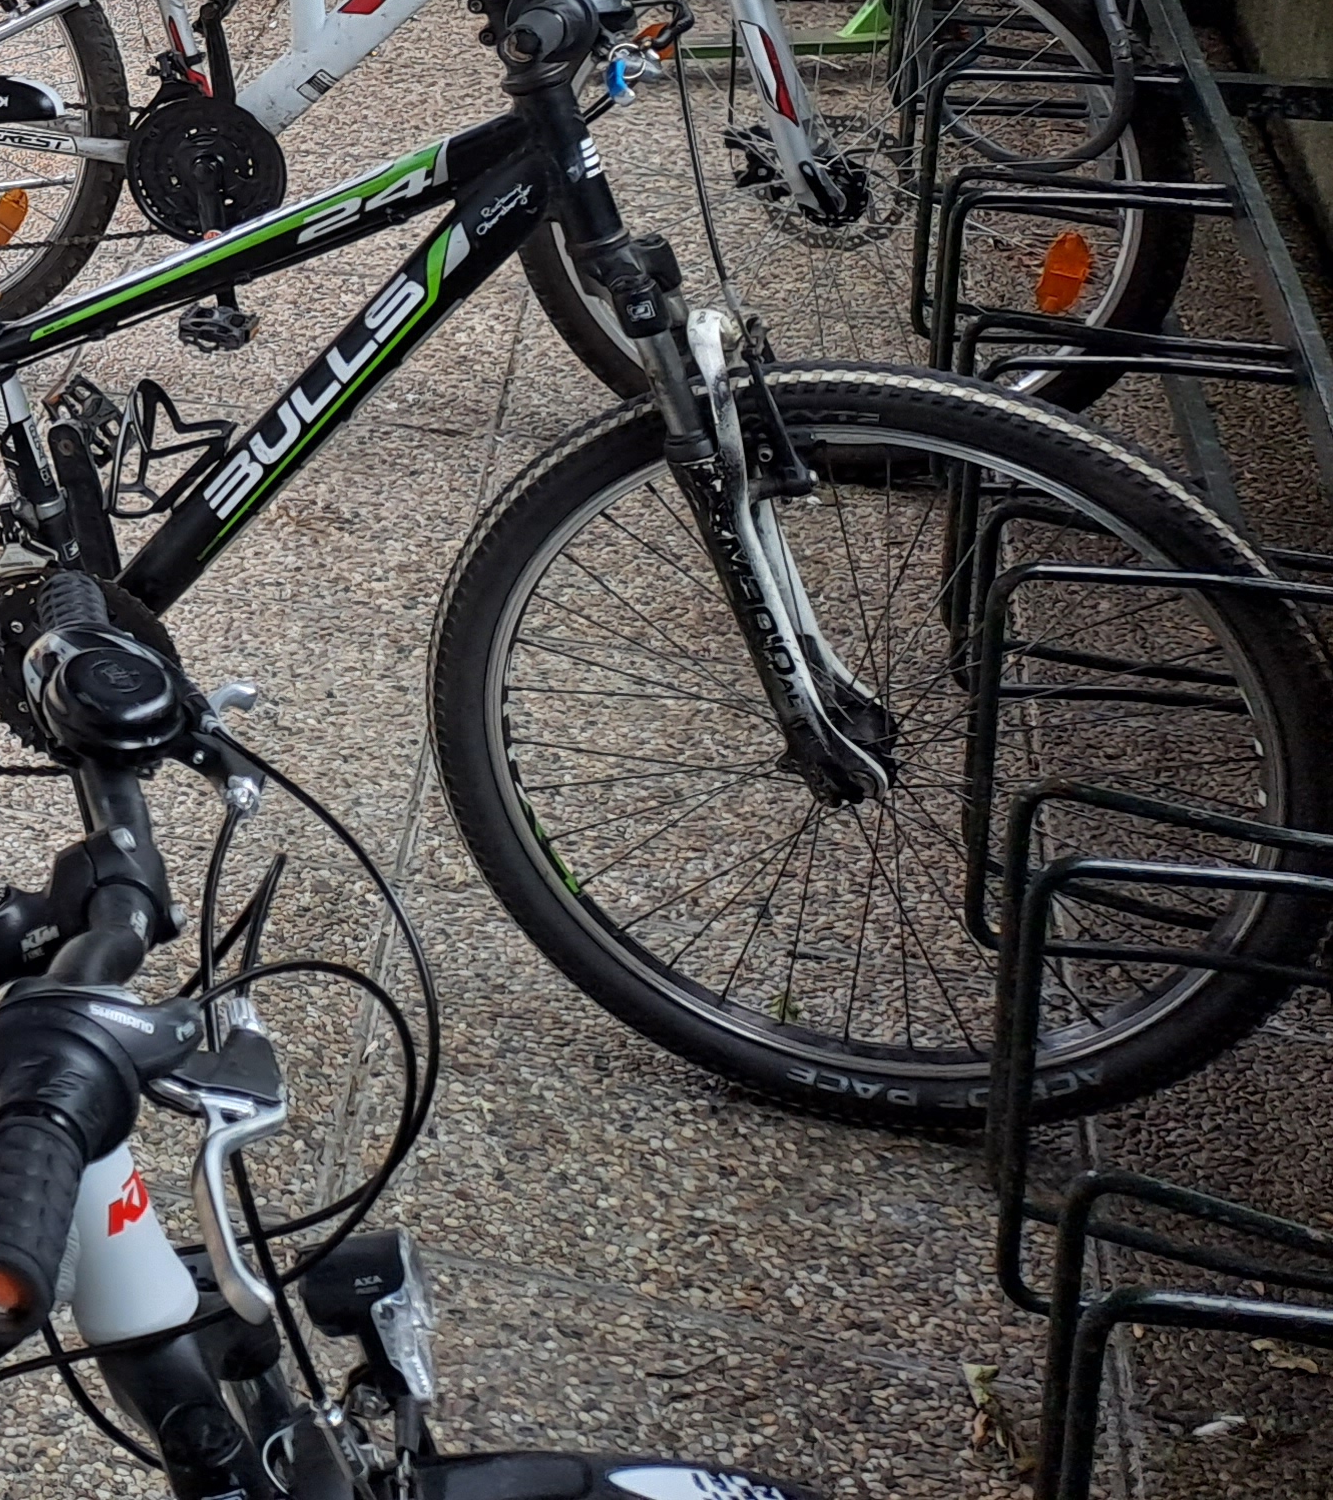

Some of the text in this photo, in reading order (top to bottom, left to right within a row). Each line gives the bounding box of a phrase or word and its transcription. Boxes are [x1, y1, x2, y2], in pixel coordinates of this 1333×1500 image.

[296, 164, 439, 245] 24
[203, 273, 426, 520] BULLS
[20, 924, 60, 953] KTM
[88, 1003, 155, 1036] SHIMANO
[786, 1064, 918, 1107] PACE
[354, 1275, 383, 1287] AXA
